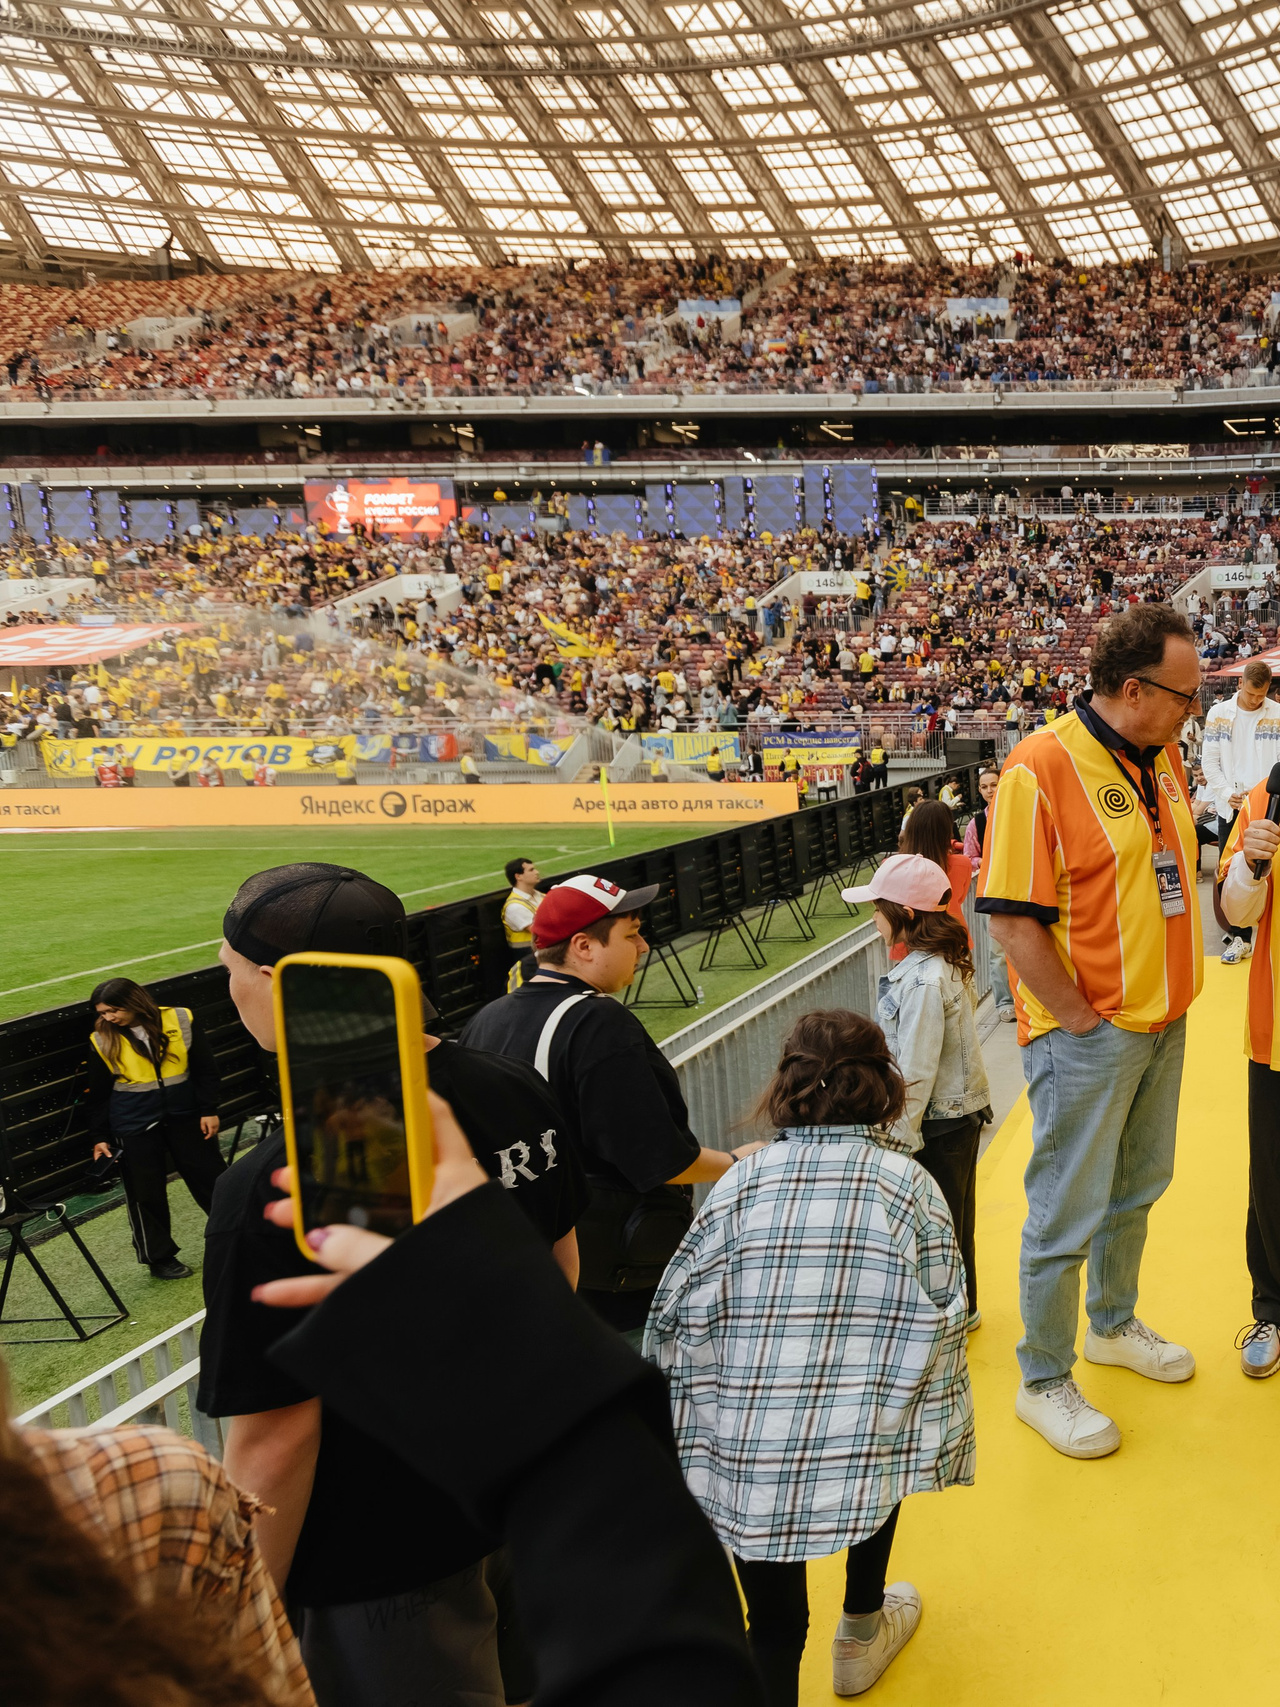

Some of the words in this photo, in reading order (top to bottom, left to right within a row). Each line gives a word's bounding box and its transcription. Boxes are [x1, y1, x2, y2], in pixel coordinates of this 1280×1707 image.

[364, 506, 397, 517] КУБОК
[398, 505, 440, 516] РОССИИ
[1225, 571, 1245, 582] 146
[815, 578, 836, 588] 148
[763, 736, 785, 745] РСМ
[673, 734, 735, 761] MANIACS
[15, 804, 61, 816] такси
[300, 795, 376, 818] Яндекс
[411, 794, 477, 817] Гараж
[573, 797, 637, 813] Аренда
[640, 799, 679, 810] авто
[682, 799, 714, 812] для
[718, 798, 765, 810] такси
